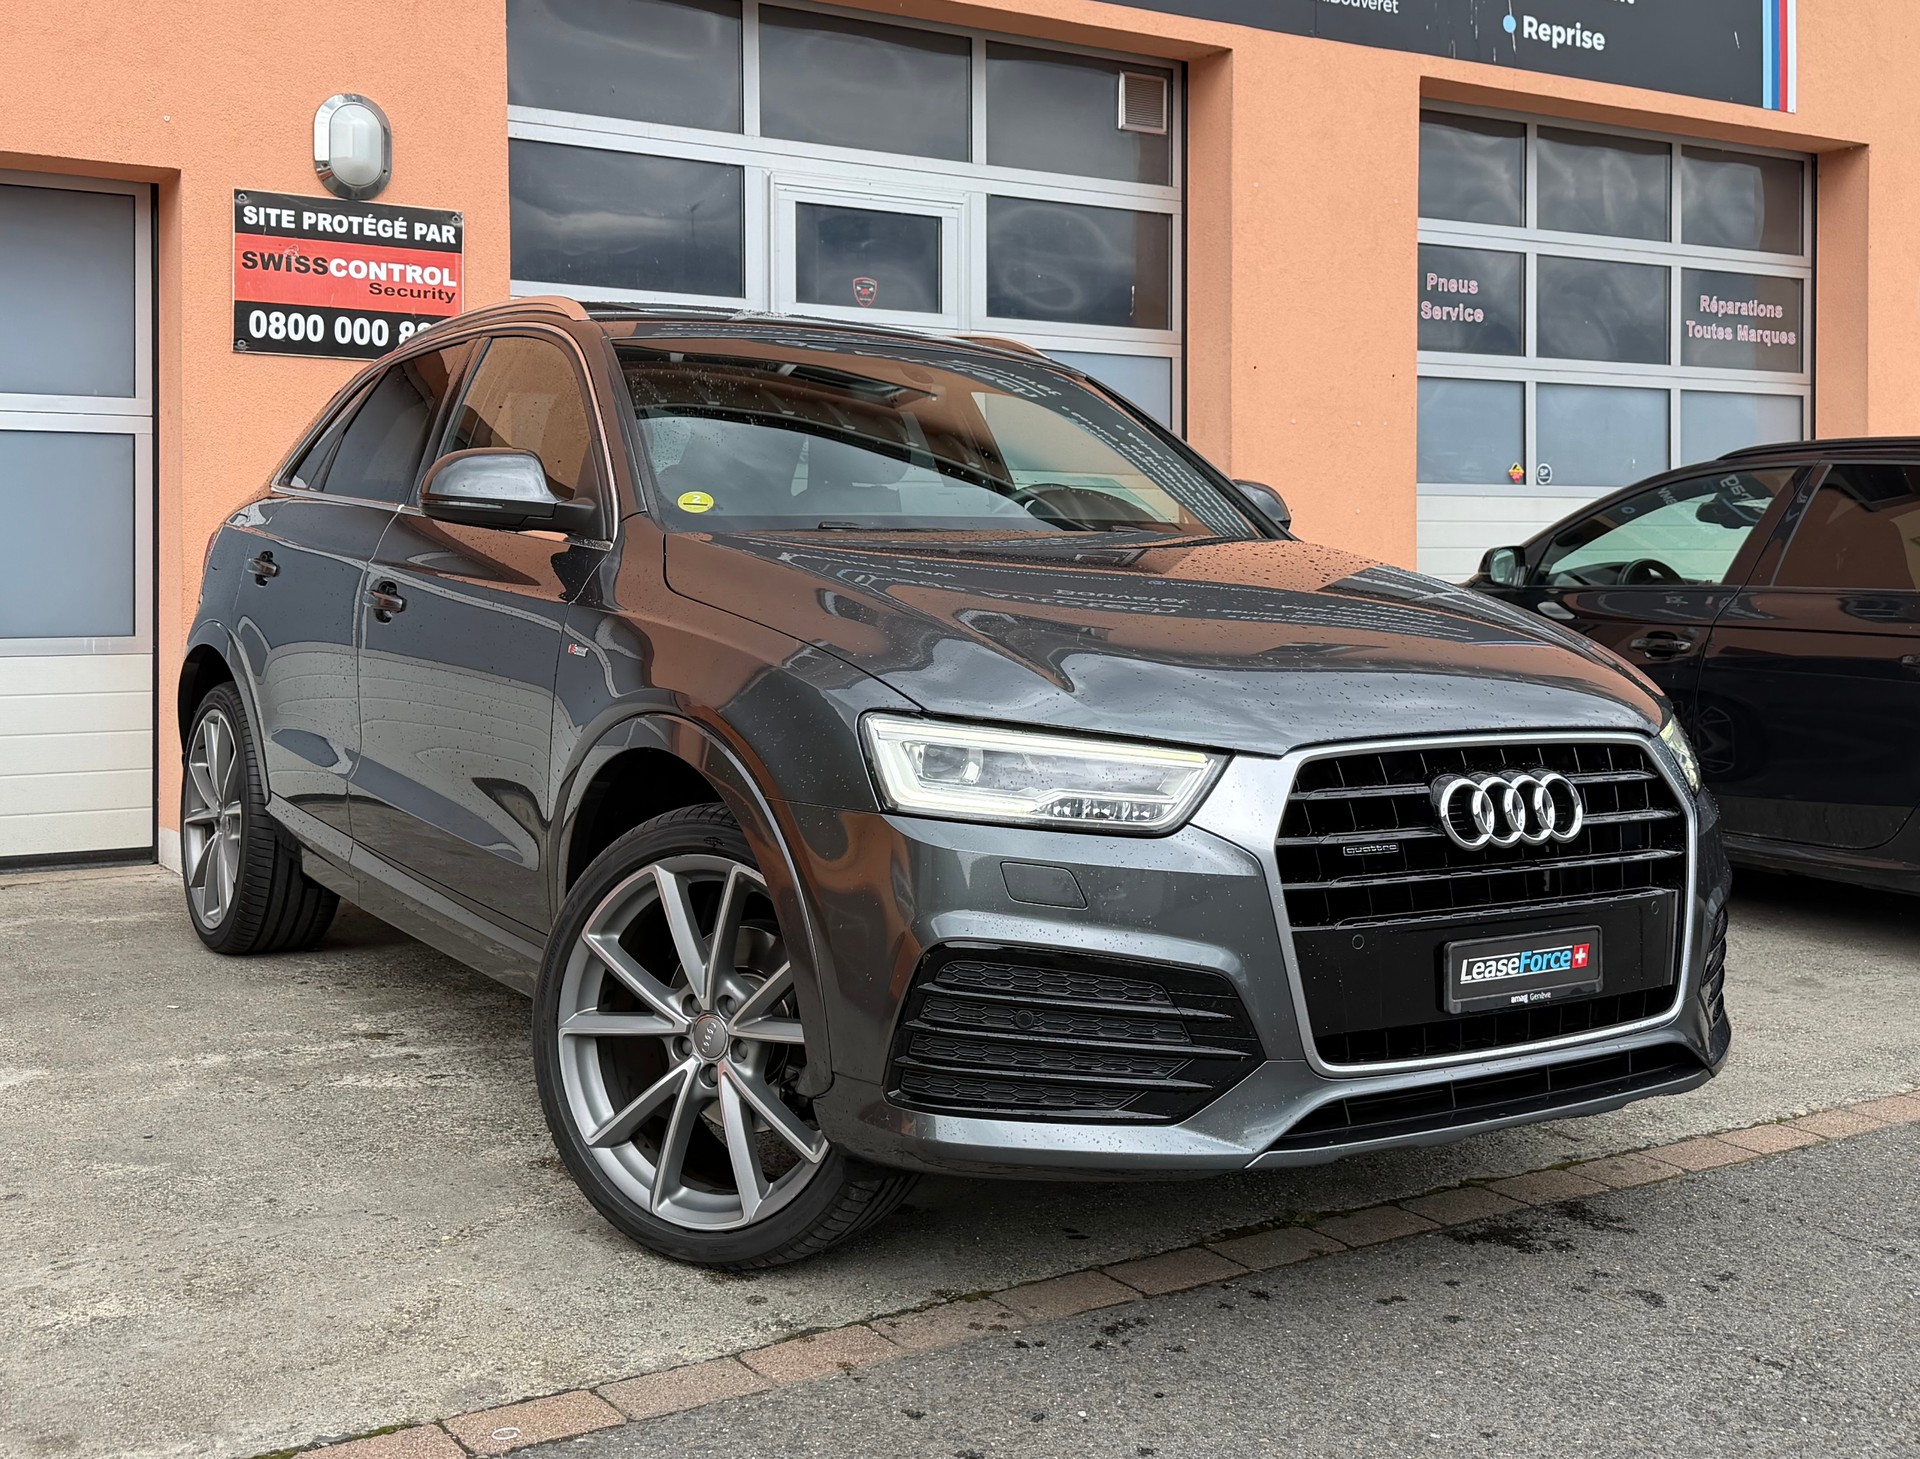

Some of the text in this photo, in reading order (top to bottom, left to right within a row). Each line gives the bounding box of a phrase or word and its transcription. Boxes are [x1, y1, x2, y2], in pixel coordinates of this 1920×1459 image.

[1523, 15, 1605, 50] Reprise
[243, 205, 456, 244] SITE PROTÉGÉ PAR
[368, 282, 456, 304] Security
[1426, 272, 1479, 295] Pneus
[1420, 300, 1484, 323] Service
[1699, 294, 1783, 318] Réparations
[249, 309, 433, 347] 0800 000 8
[1686, 320, 1797, 347] Toutes Marques
[1460, 950, 1571, 981] LeaseForce
